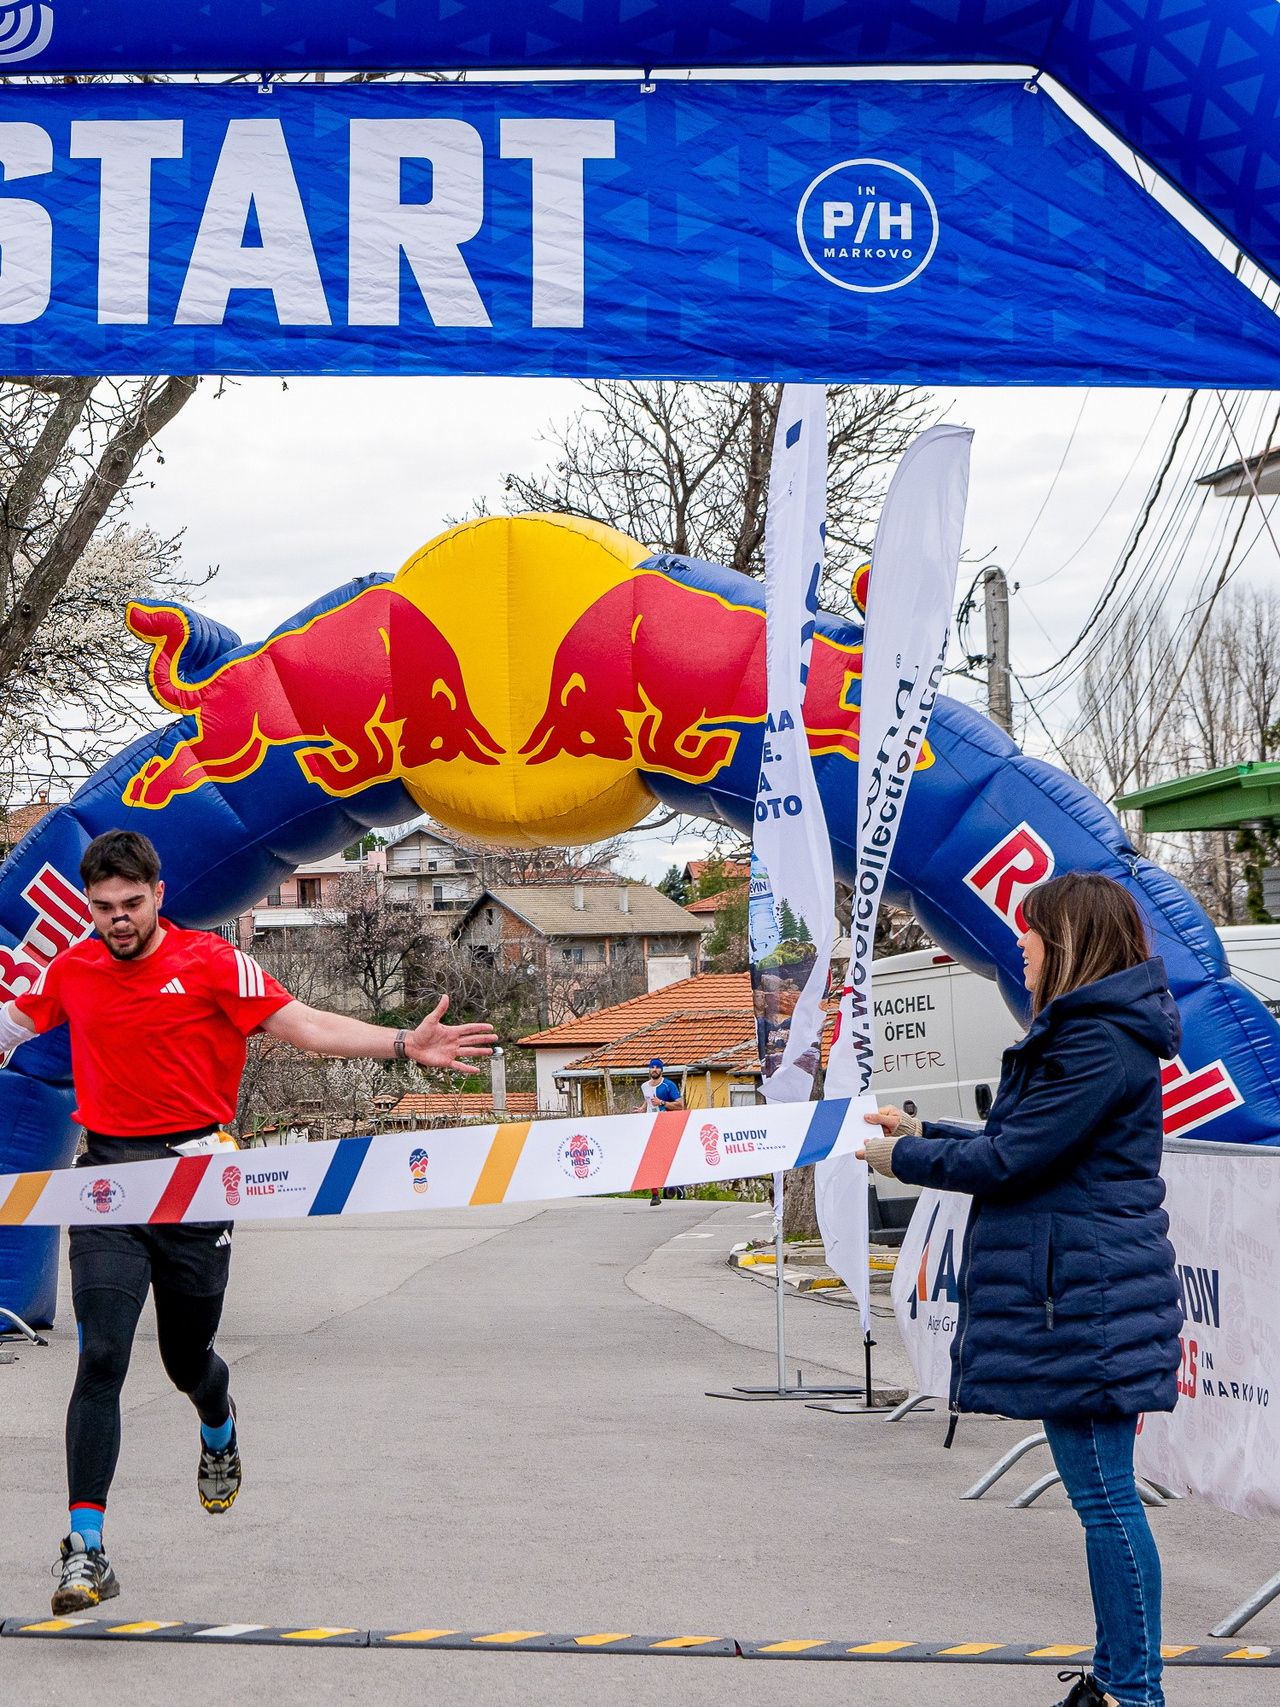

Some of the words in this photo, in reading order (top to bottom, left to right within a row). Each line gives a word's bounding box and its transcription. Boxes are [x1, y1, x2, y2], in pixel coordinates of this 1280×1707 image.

[858, 186, 876, 195] IN
[823, 201, 912, 244] P/H
[824, 248, 912, 259] MARKOVO
[873, 994, 935, 1017] KACHEL
[884, 1021, 926, 1041] ÖFEN
[723, 1129, 767, 1142] PLOVDIV
[725, 1142, 755, 1154] HILLS
[245, 1170, 289, 1184] PLOVDIV
[246, 1184, 275, 1195] HILLS
[1201, 1350, 1214, 1370] IN
[1202, 1379, 1269, 1407] MARKOVO
